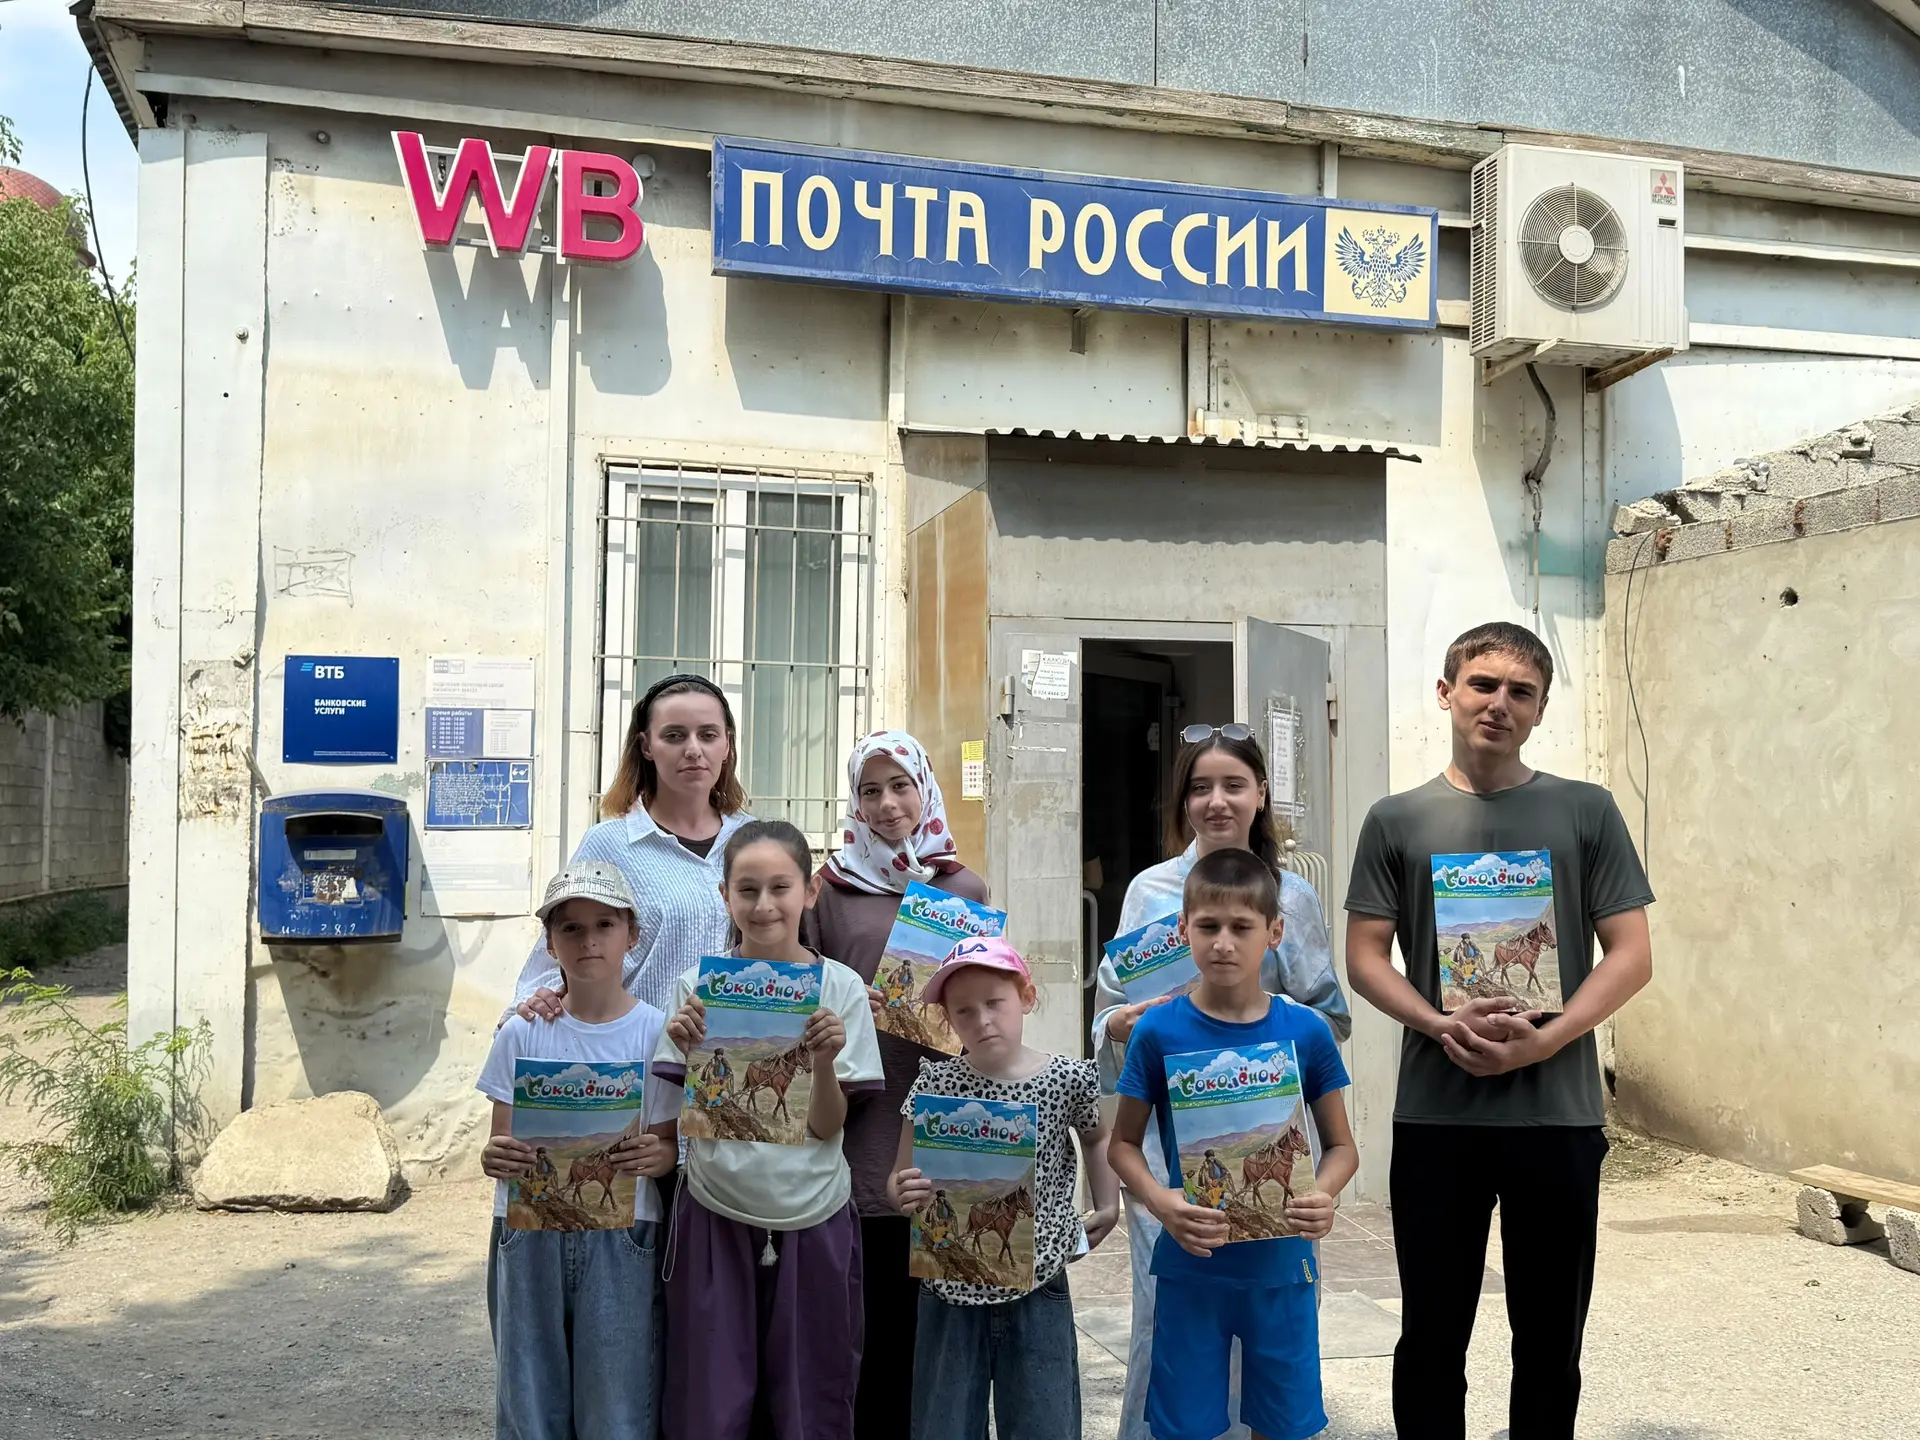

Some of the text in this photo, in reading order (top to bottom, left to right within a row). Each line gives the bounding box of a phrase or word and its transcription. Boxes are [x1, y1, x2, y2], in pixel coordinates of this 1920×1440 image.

[391, 129, 646, 266] WB
[741, 168, 1310, 292] ПОЧТА РОССИИ
[314, 665, 345, 679] ВТБ
[314, 698, 367, 707] БАНКОВСКИЕ
[314, 707, 346, 715] УСЛУГИ
